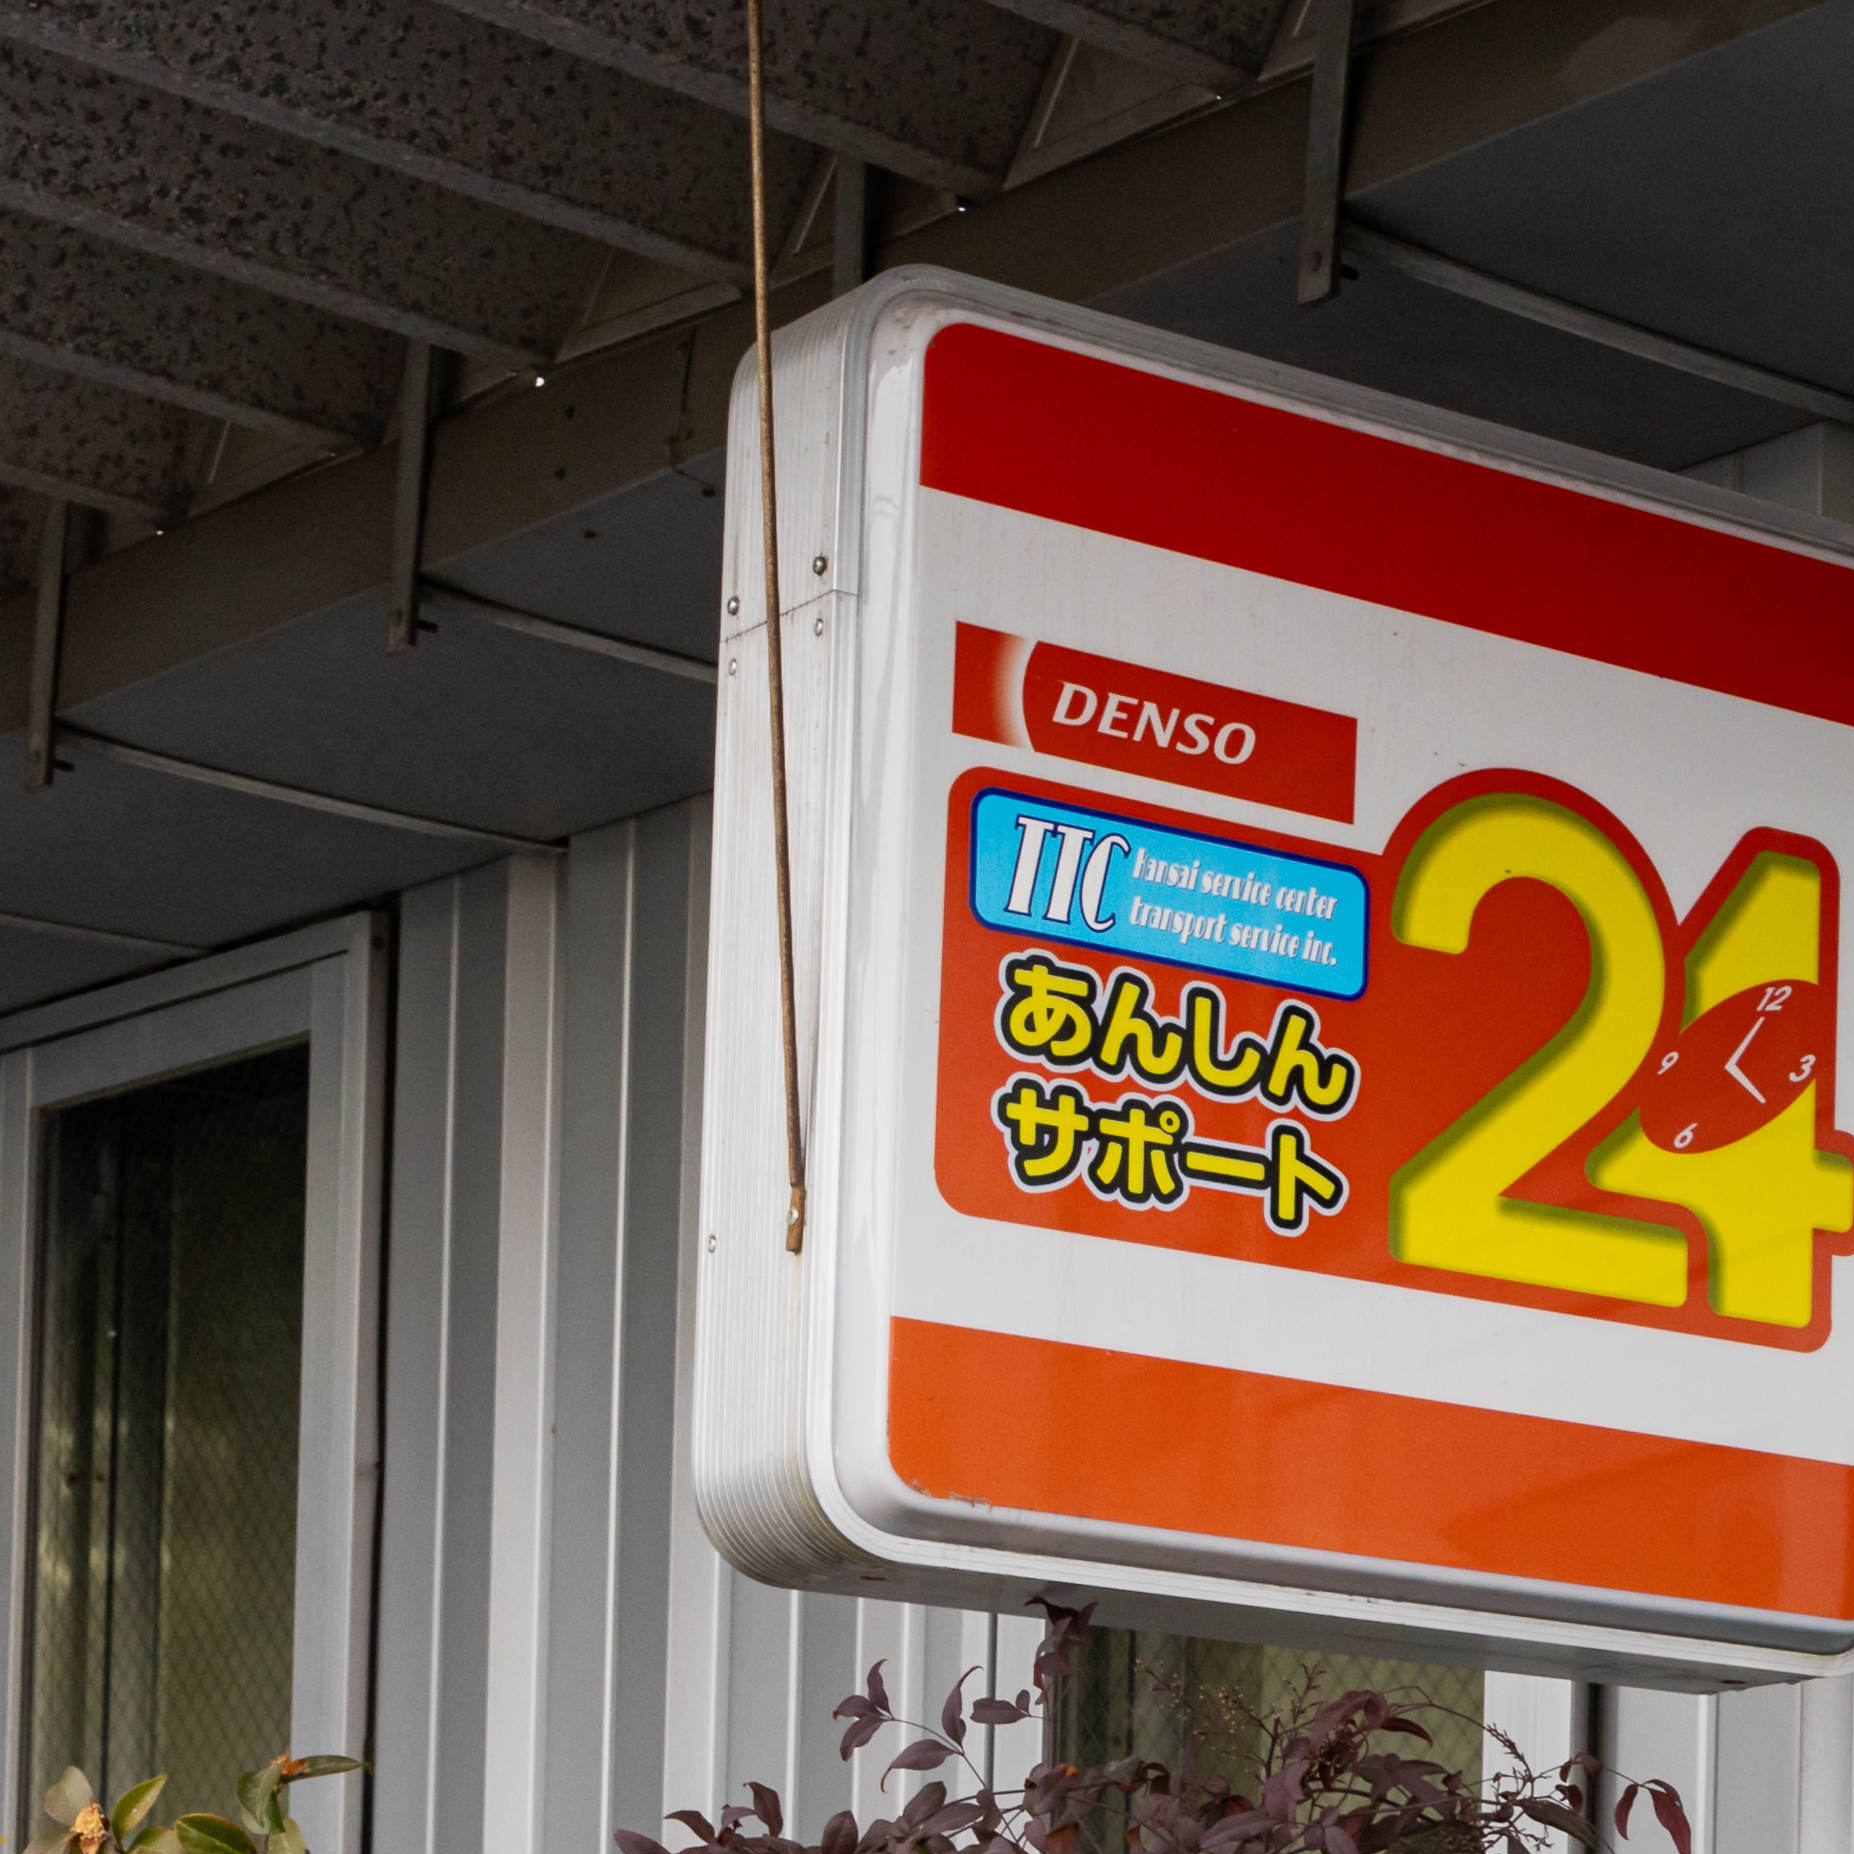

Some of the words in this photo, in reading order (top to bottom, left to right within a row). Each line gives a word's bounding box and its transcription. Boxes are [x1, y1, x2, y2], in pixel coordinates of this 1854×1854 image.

[1052, 681, 1256, 765] DENSO
[1003, 813, 1132, 933] TTC
[1201, 869, 1273, 907] service
[1275, 886, 1339, 921] center
[1129, 895, 1228, 945] transport
[1228, 917, 1300, 957] service
[1299, 931, 1338, 966] inc.
[1000, 957, 1353, 1108] あんしん
[1756, 985, 1792, 1012] 12
[1392, 792, 1854, 1329] 24
[1656, 1051, 1680, 1076] 9
[1788, 1054, 1817, 1083] 3
[1000, 1083, 1342, 1228] サポート
[1673, 1122, 1699, 1149] 6
